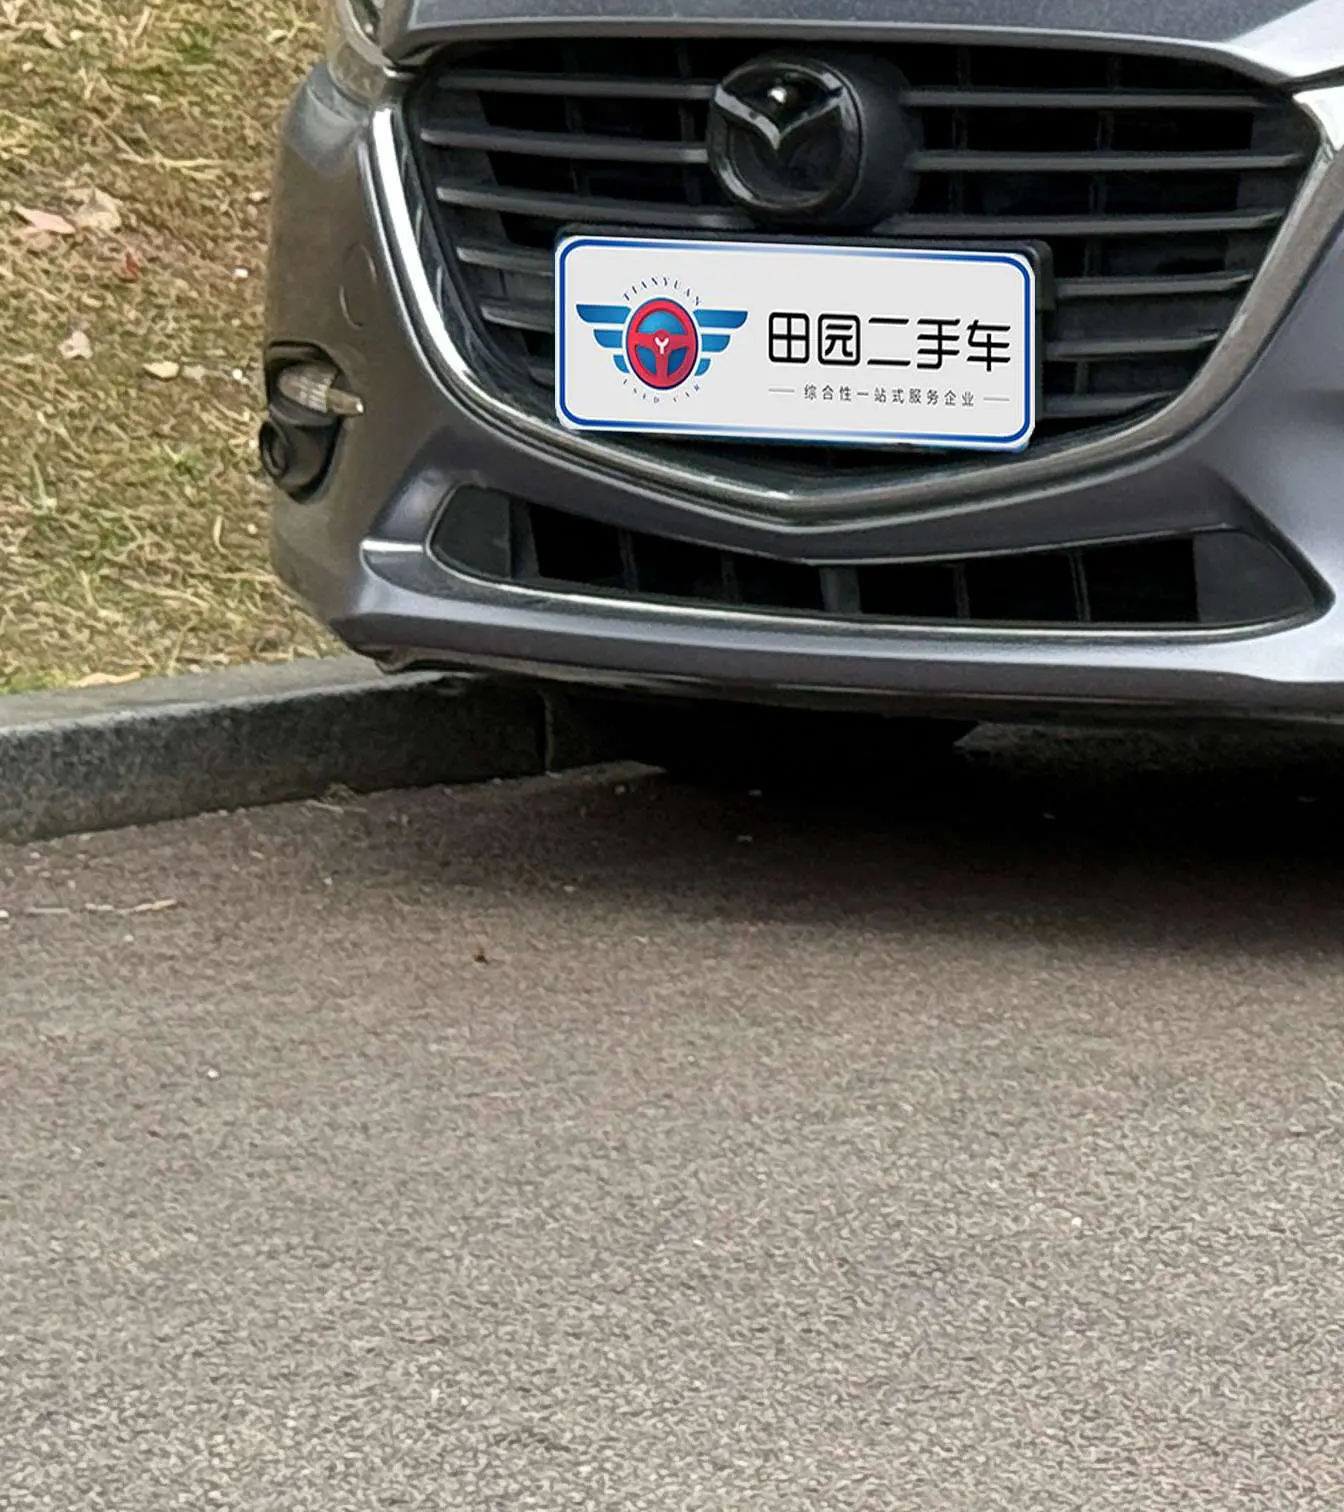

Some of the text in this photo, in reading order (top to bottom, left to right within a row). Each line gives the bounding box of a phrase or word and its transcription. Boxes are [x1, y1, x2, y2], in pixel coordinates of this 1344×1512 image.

[768, 311, 1012, 373] 田园二手车
[803, 383, 975, 408] 综合性一站式服务企业
